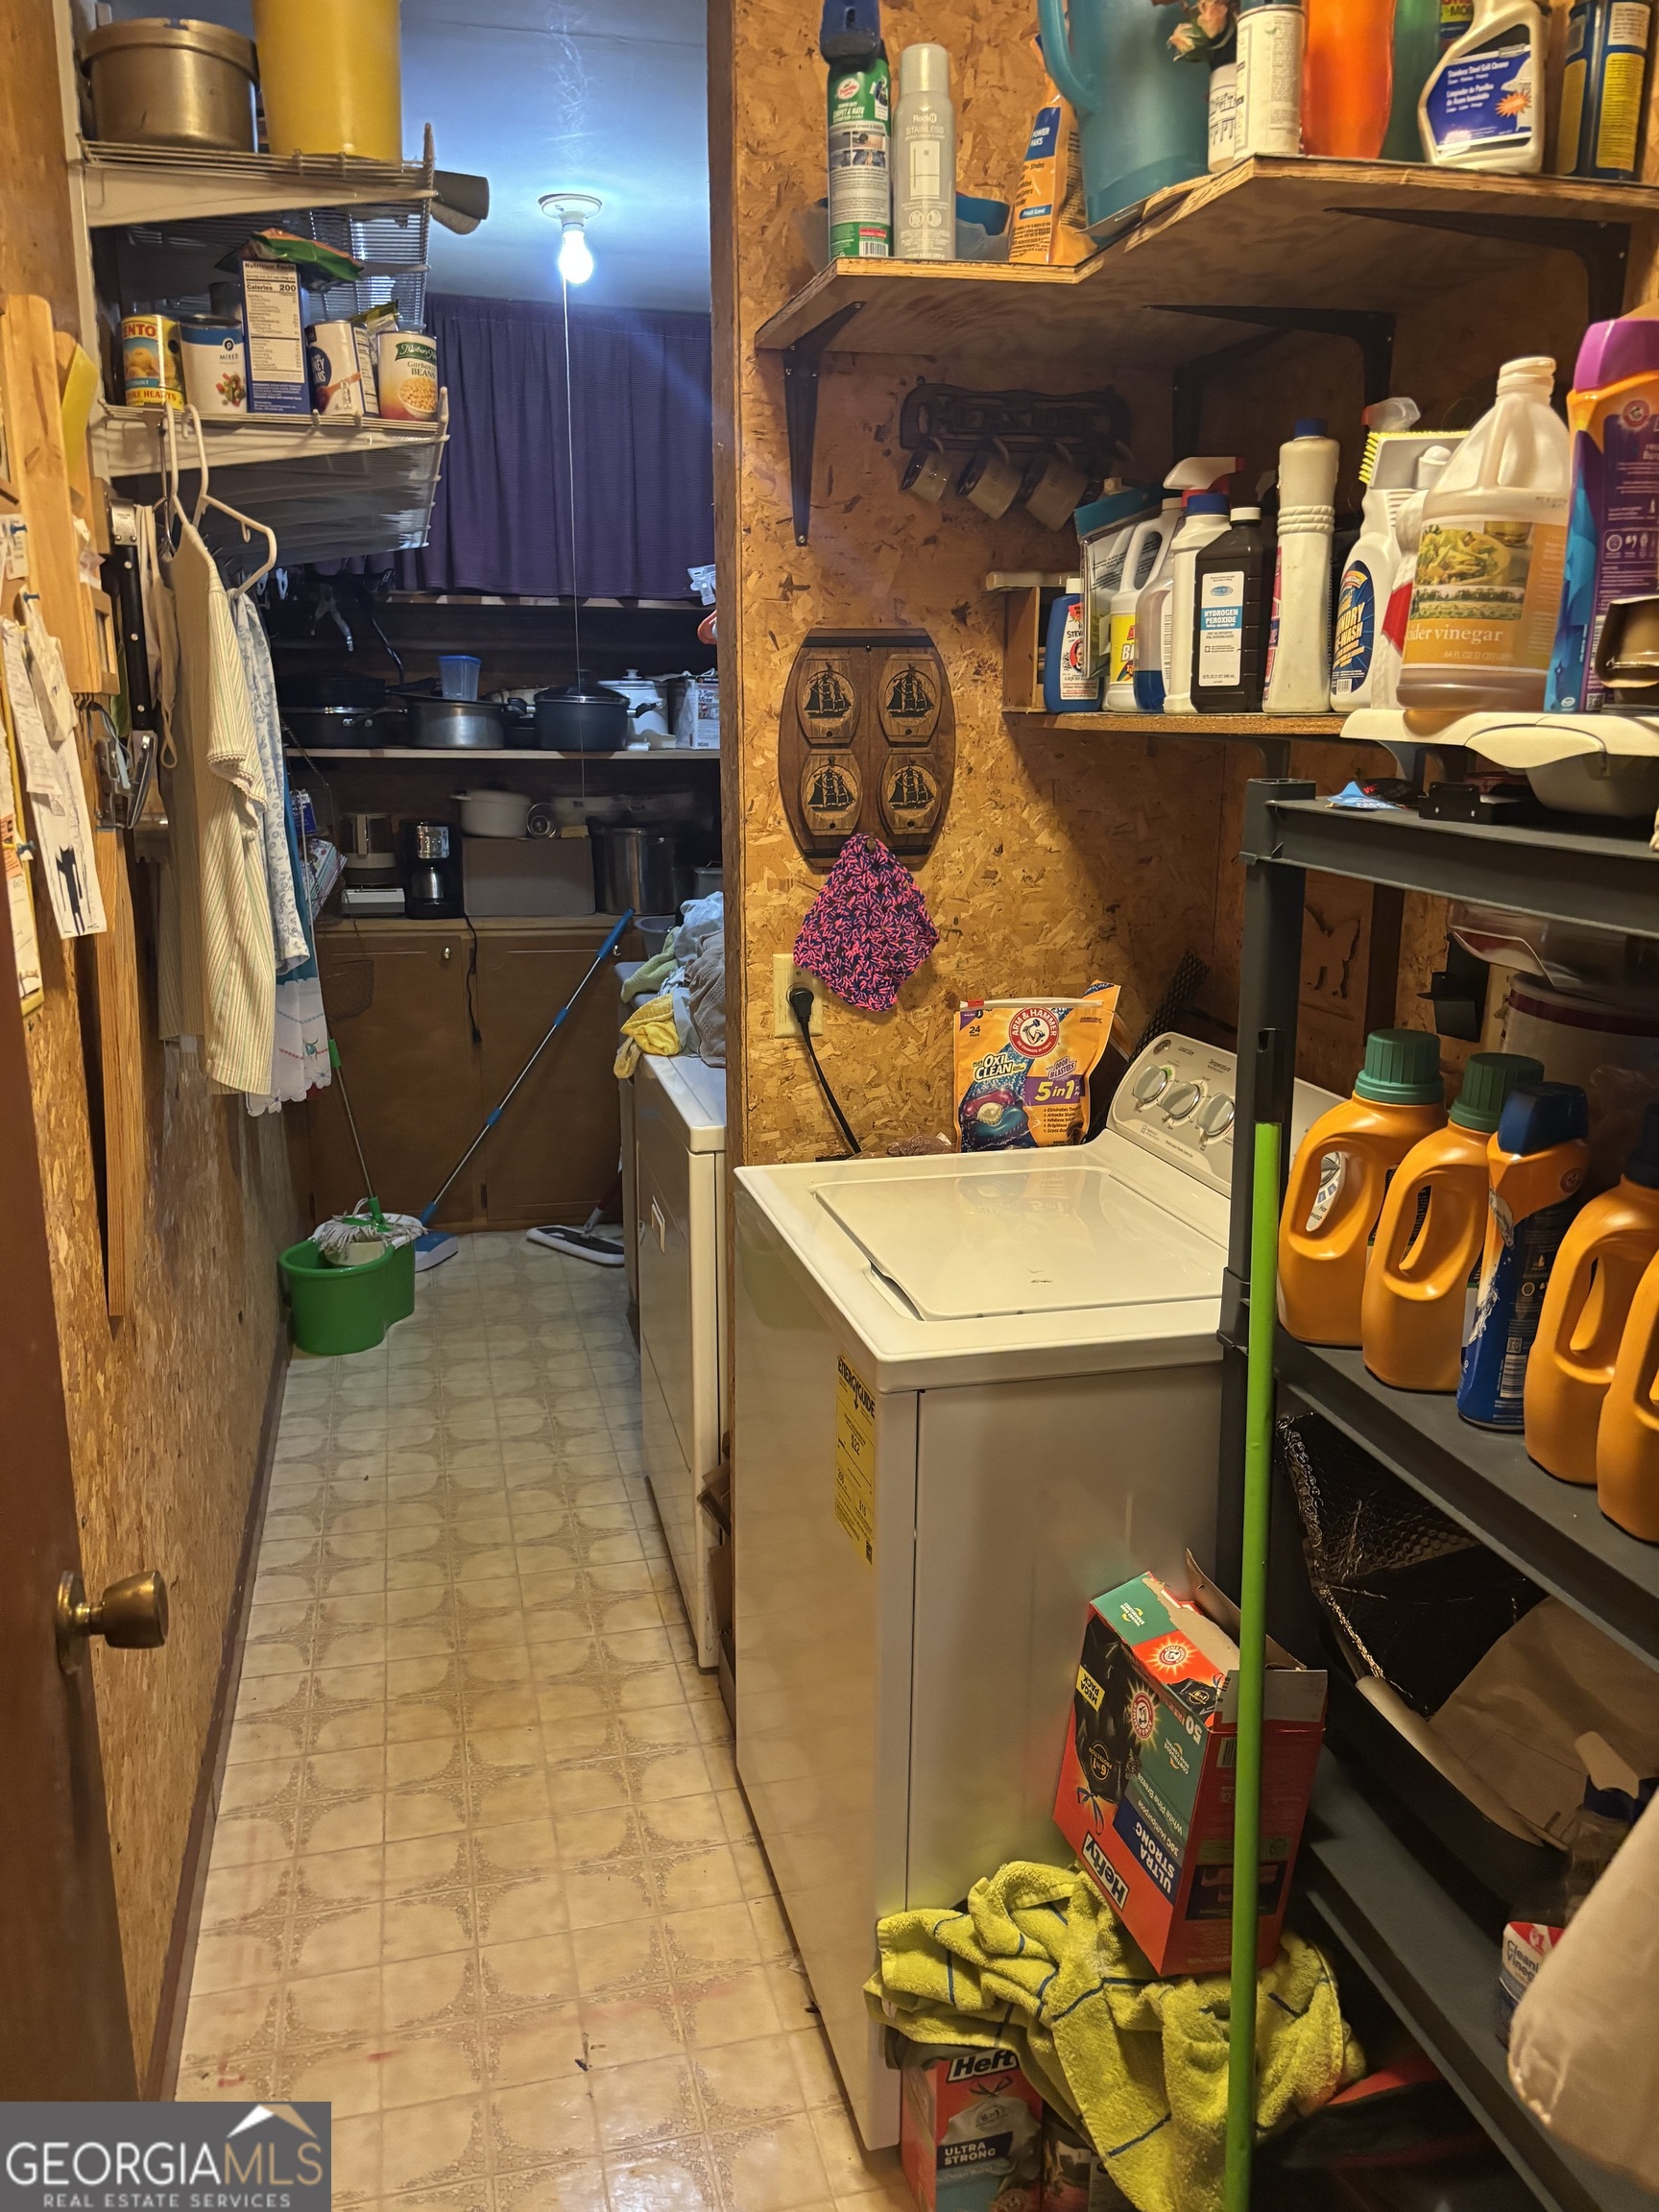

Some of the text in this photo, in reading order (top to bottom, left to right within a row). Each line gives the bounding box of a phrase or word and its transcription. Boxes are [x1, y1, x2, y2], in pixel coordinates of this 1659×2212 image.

[1204, 608, 1238, 617] HYDROGEN
[1205, 615, 1237, 624] PEROXIDE
[1434, 623, 1503, 645] vinegar
[1012, 1017, 1023, 1036] ARM
[1029, 1009, 1057, 1037] HAMMER
[975, 1063, 1013, 1080] CLEAN
[984, 1054, 1005, 1067] OXI
[1050, 1063, 1075, 1079] BLASTERS
[1055, 1056, 1070, 1070] ODOR
[1080, 1682, 1097, 1706] MEGA
[1083, 1673, 1099, 1697] PACK
[1186, 1715, 1203, 1744] 50
[1089, 1747, 1113, 1769] PROTECTION
[1164, 1742, 1189, 1774] CONTINUOUS
[1153, 1793, 1166, 1811] Pine
[1137, 1800, 1166, 1839] Multipurpose
[1165, 1811, 1183, 1836] White
[1135, 1821, 1175, 1879] STRONG
[1086, 1839, 1125, 1905] Hefty
[1140, 1843, 1171, 1894] ULTRA
[1507, 1939, 1539, 1974] Cleani
[952, 2050, 1016, 2078] Heft
[944, 2148, 996, 2166] STRONG
[945, 2142, 986, 2156] ULTRA
